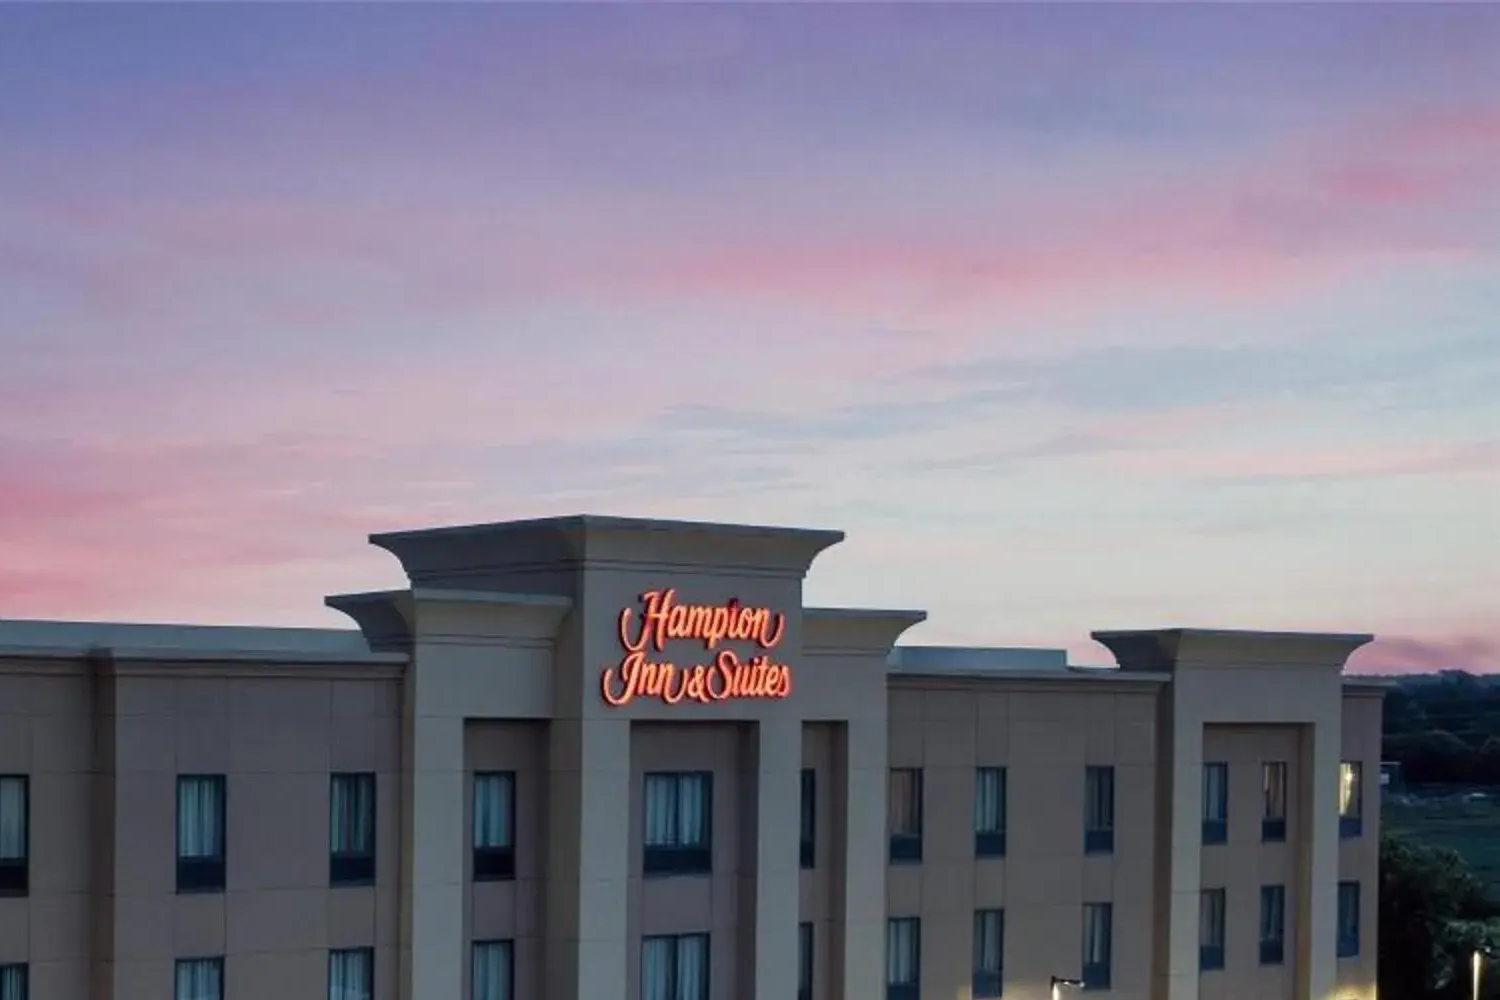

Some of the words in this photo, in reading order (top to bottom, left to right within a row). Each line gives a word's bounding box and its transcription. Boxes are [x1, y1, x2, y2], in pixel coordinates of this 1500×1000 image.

[620, 588, 785, 652] Hampton
[602, 651, 689, 706] Inn
[687, 663, 710, 704] &
[706, 648, 792, 700] Suites
